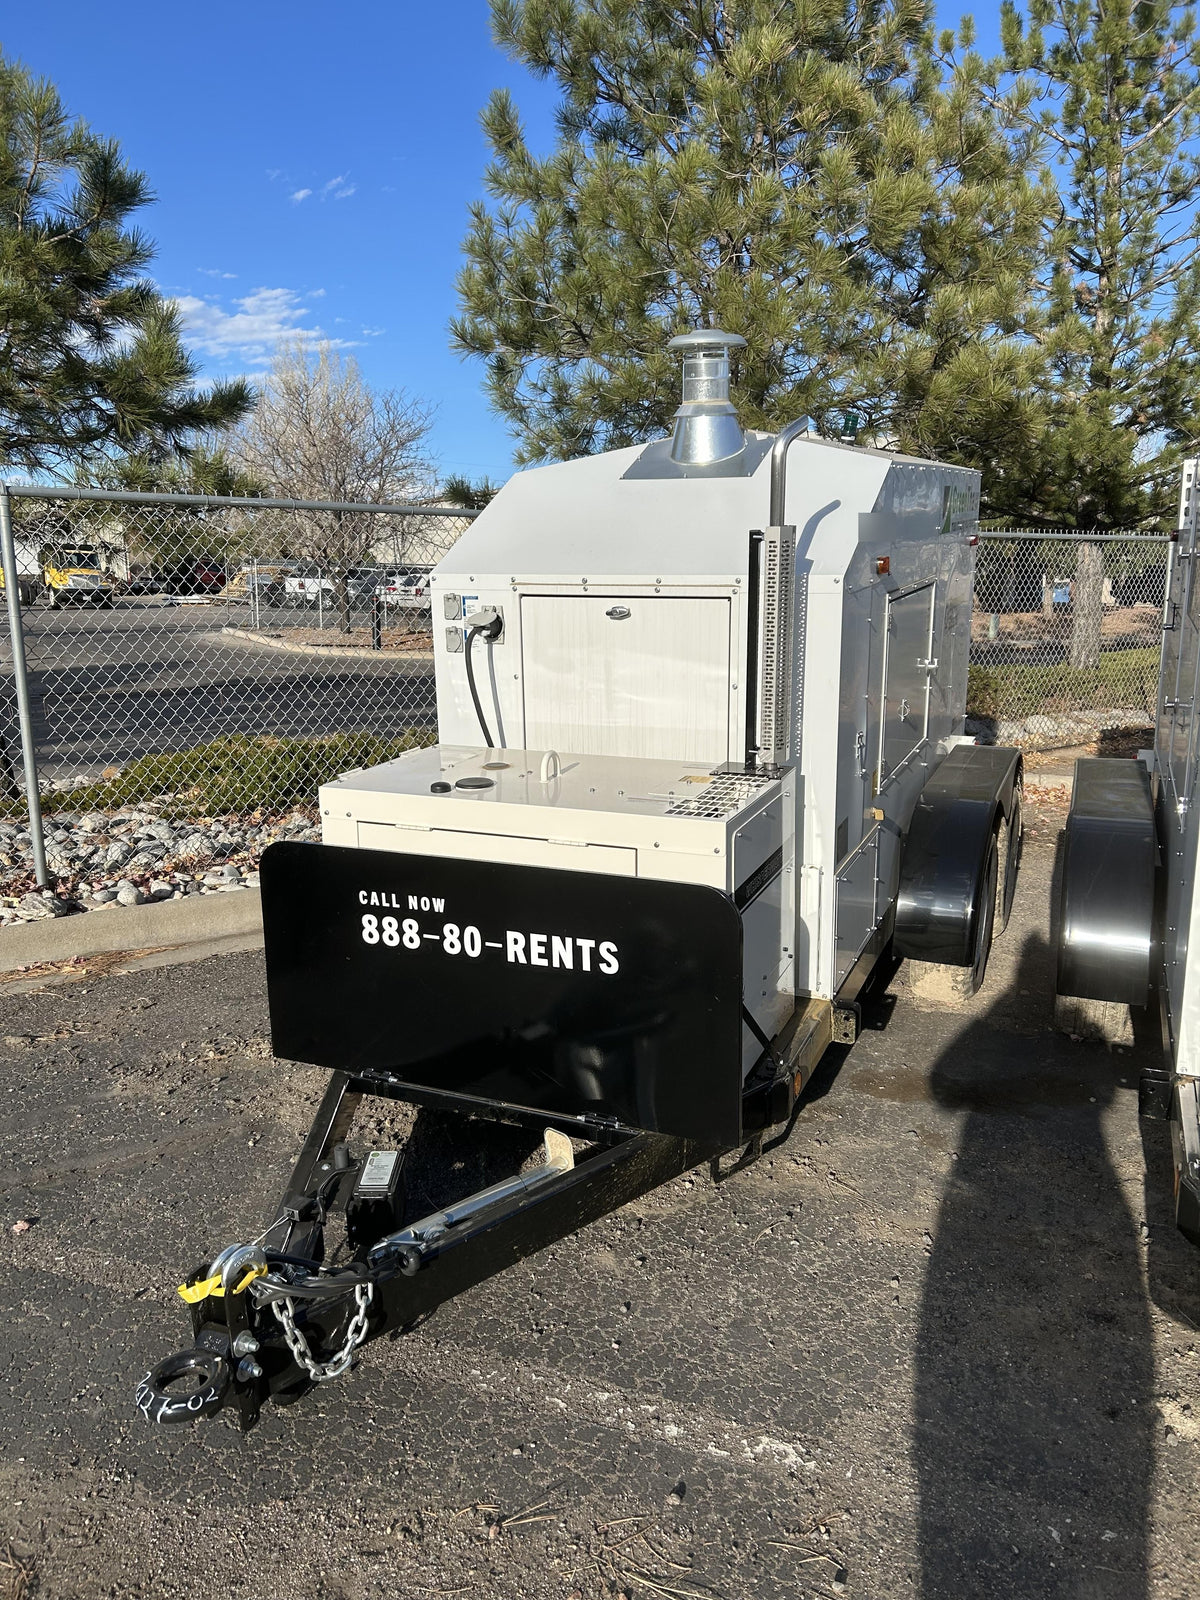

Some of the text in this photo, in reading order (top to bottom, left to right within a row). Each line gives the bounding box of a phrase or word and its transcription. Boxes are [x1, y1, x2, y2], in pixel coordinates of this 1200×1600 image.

[358, 890, 445, 913] CALL NOW
[361, 913, 620, 975] 888-80-RENTS
